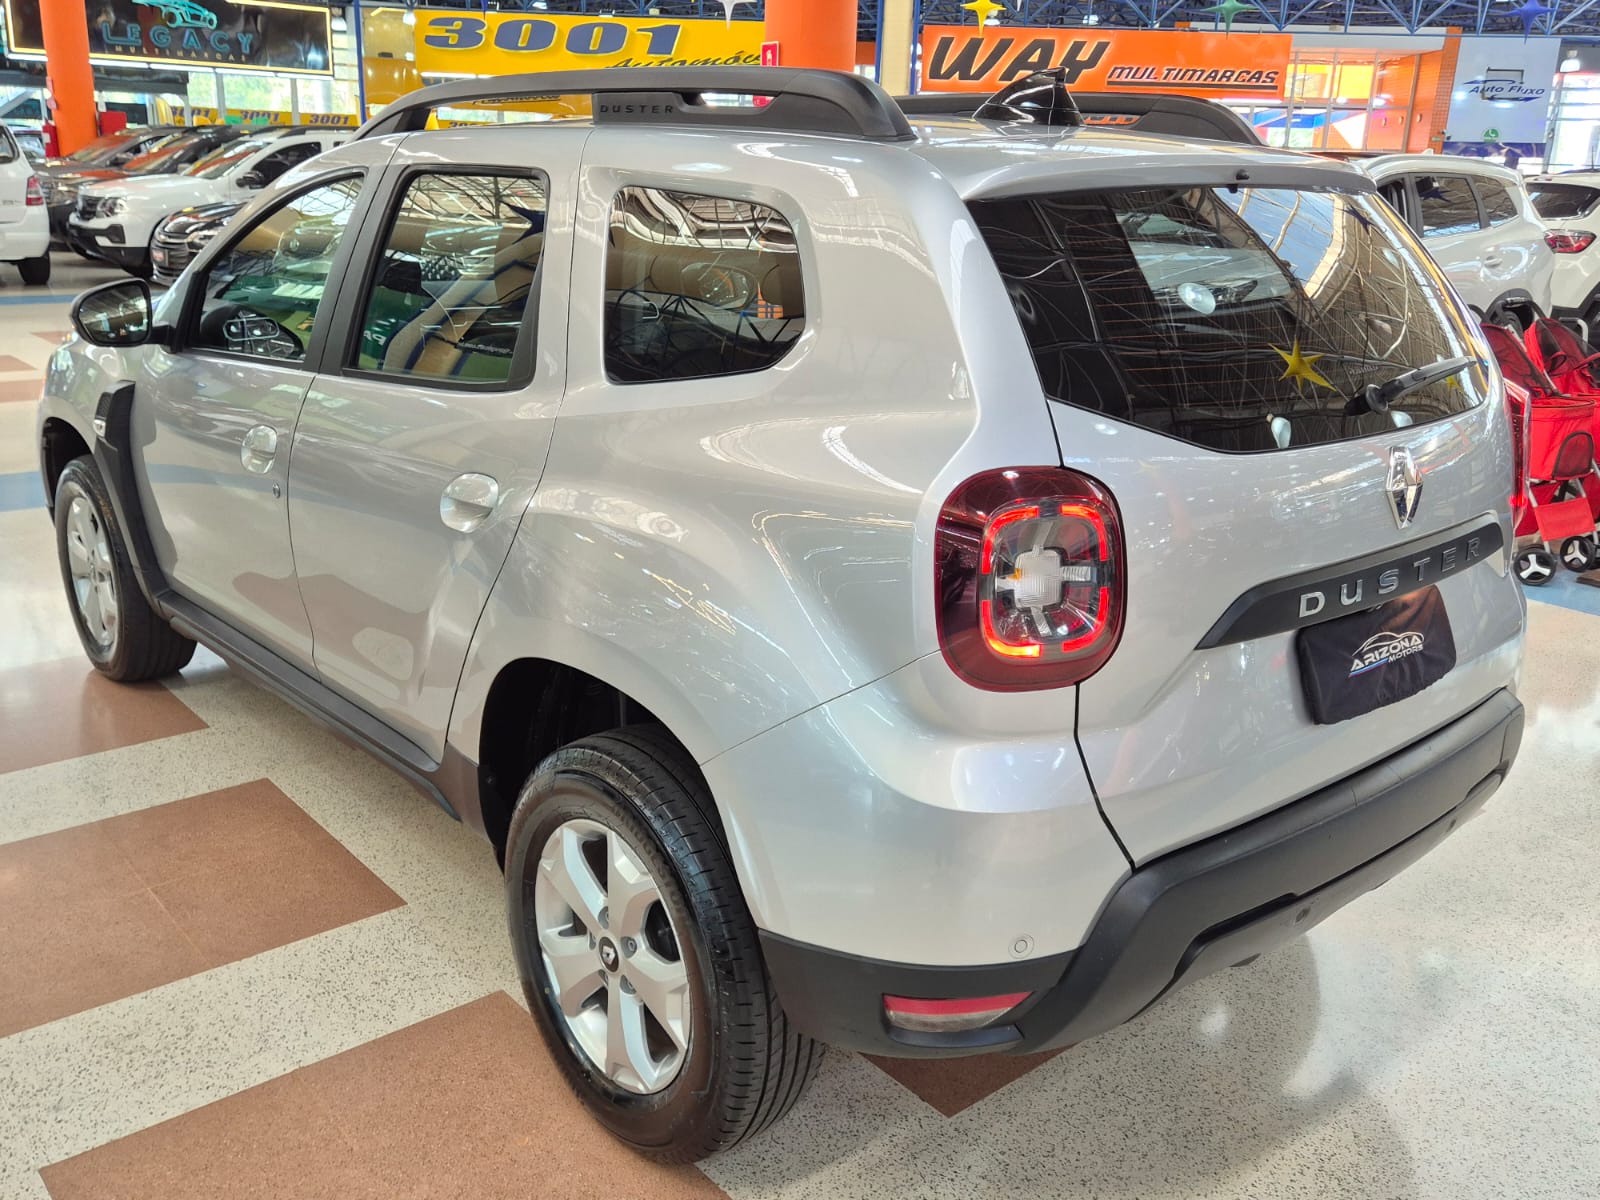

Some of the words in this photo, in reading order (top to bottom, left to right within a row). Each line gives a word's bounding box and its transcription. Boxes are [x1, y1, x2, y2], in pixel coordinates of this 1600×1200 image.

[102, 22, 254, 54] LEGACY
[425, 17, 682, 56] 3001
[927, 35, 1111, 85] WAY
[1107, 65, 1280, 85] MULTIMARCAS
[1468, 85, 1505, 95] Auto
[1507, 85, 1546, 96] Fluxo
[308, 113, 351, 126] 3001
[600, 104, 674, 114] DUSTER
[1298, 537, 1483, 619] DUSTER
[1350, 634, 1423, 672] ARIZONA
[1387, 643, 1425, 664] MOTORS
